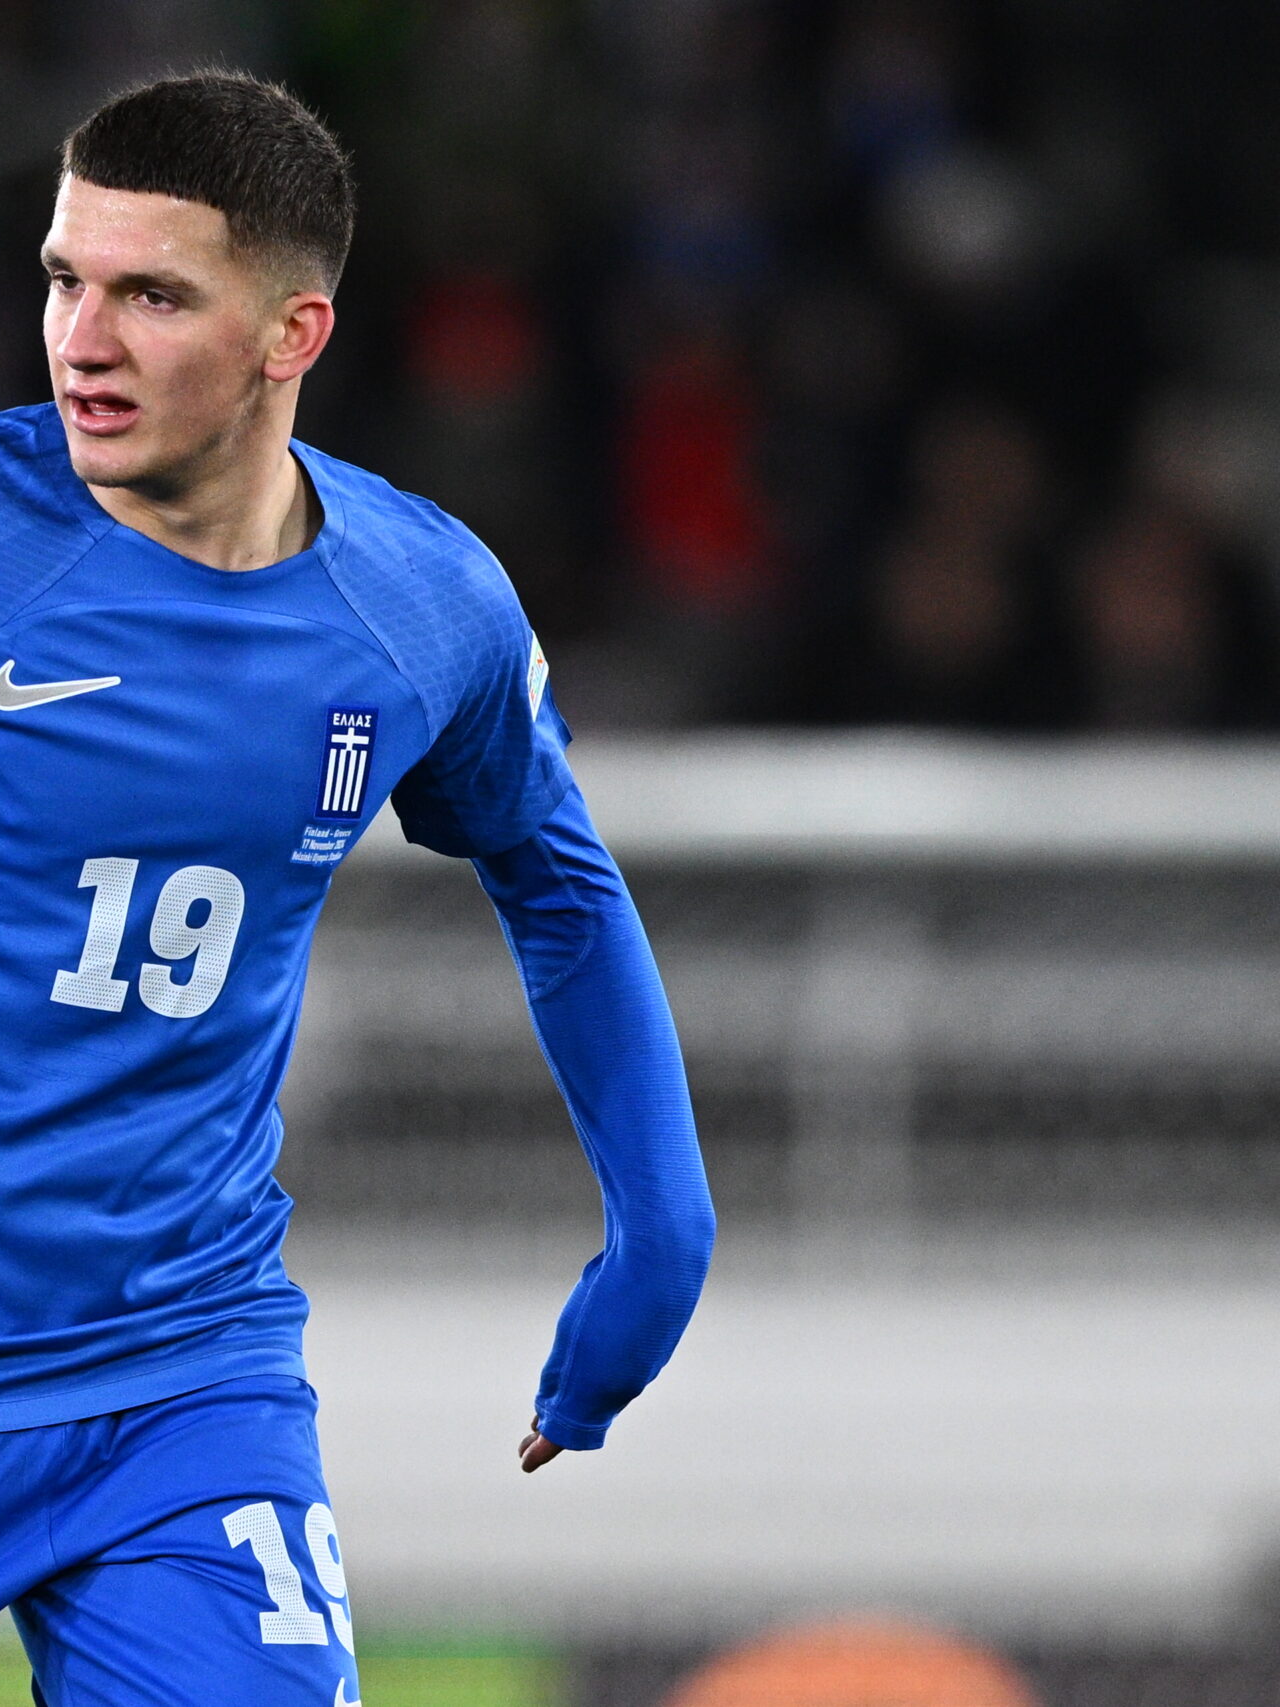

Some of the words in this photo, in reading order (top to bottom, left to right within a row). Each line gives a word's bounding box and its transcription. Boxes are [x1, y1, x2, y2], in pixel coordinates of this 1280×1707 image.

[332, 712, 372, 728] ΕΛΛΑΣ
[304, 827, 330, 838] Finland
[302, 839, 310, 849] 17
[50, 857, 245, 1019] 19
[222, 1501, 355, 1657] 19
